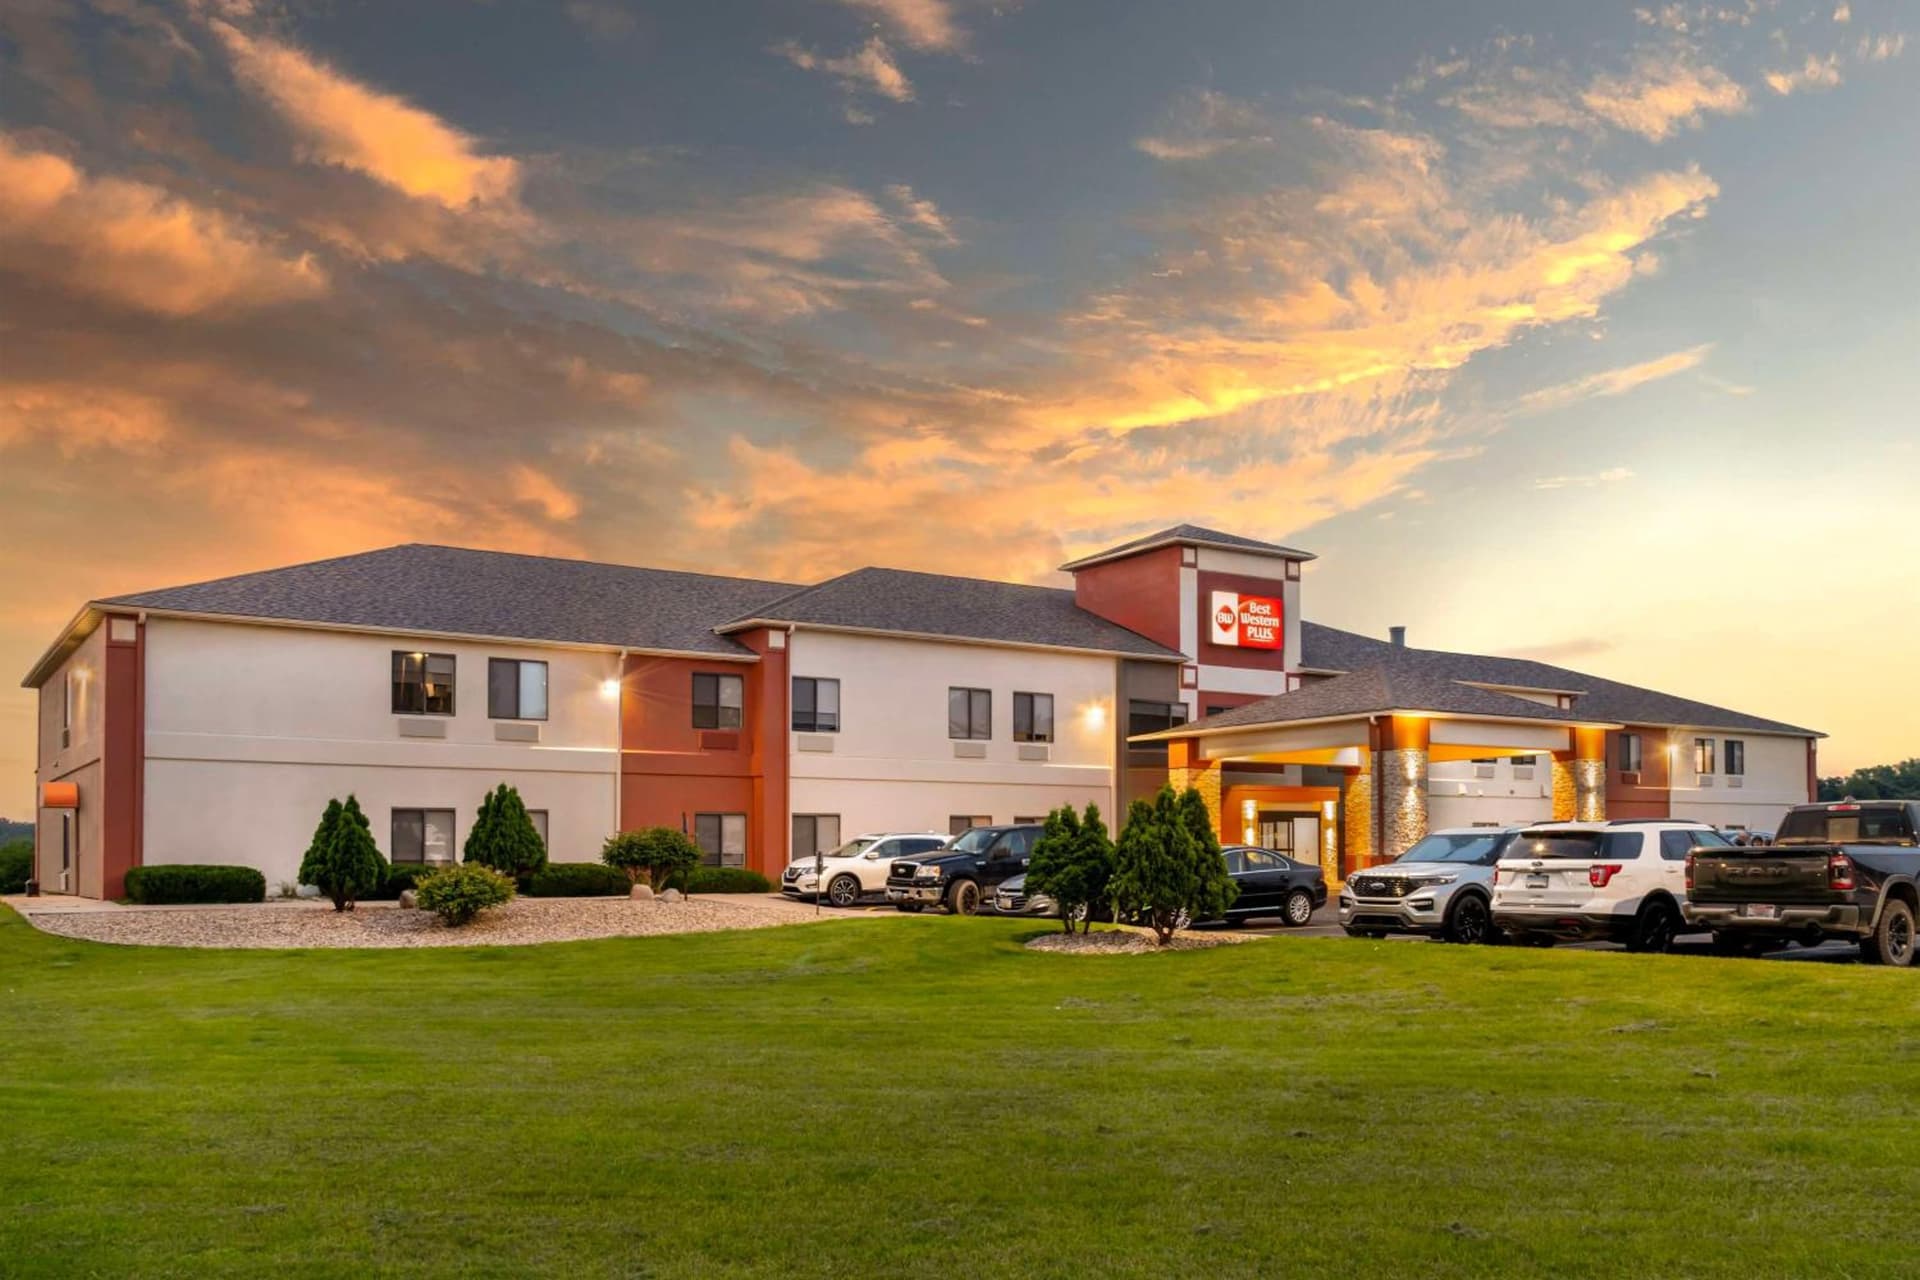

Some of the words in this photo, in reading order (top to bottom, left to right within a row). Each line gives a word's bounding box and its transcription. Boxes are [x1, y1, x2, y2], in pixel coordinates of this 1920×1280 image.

[1249, 601, 1272, 615] Best
[1217, 612, 1234, 624] BW
[1240, 612, 1280, 627] Western
[1725, 866, 1789, 878] RAM
